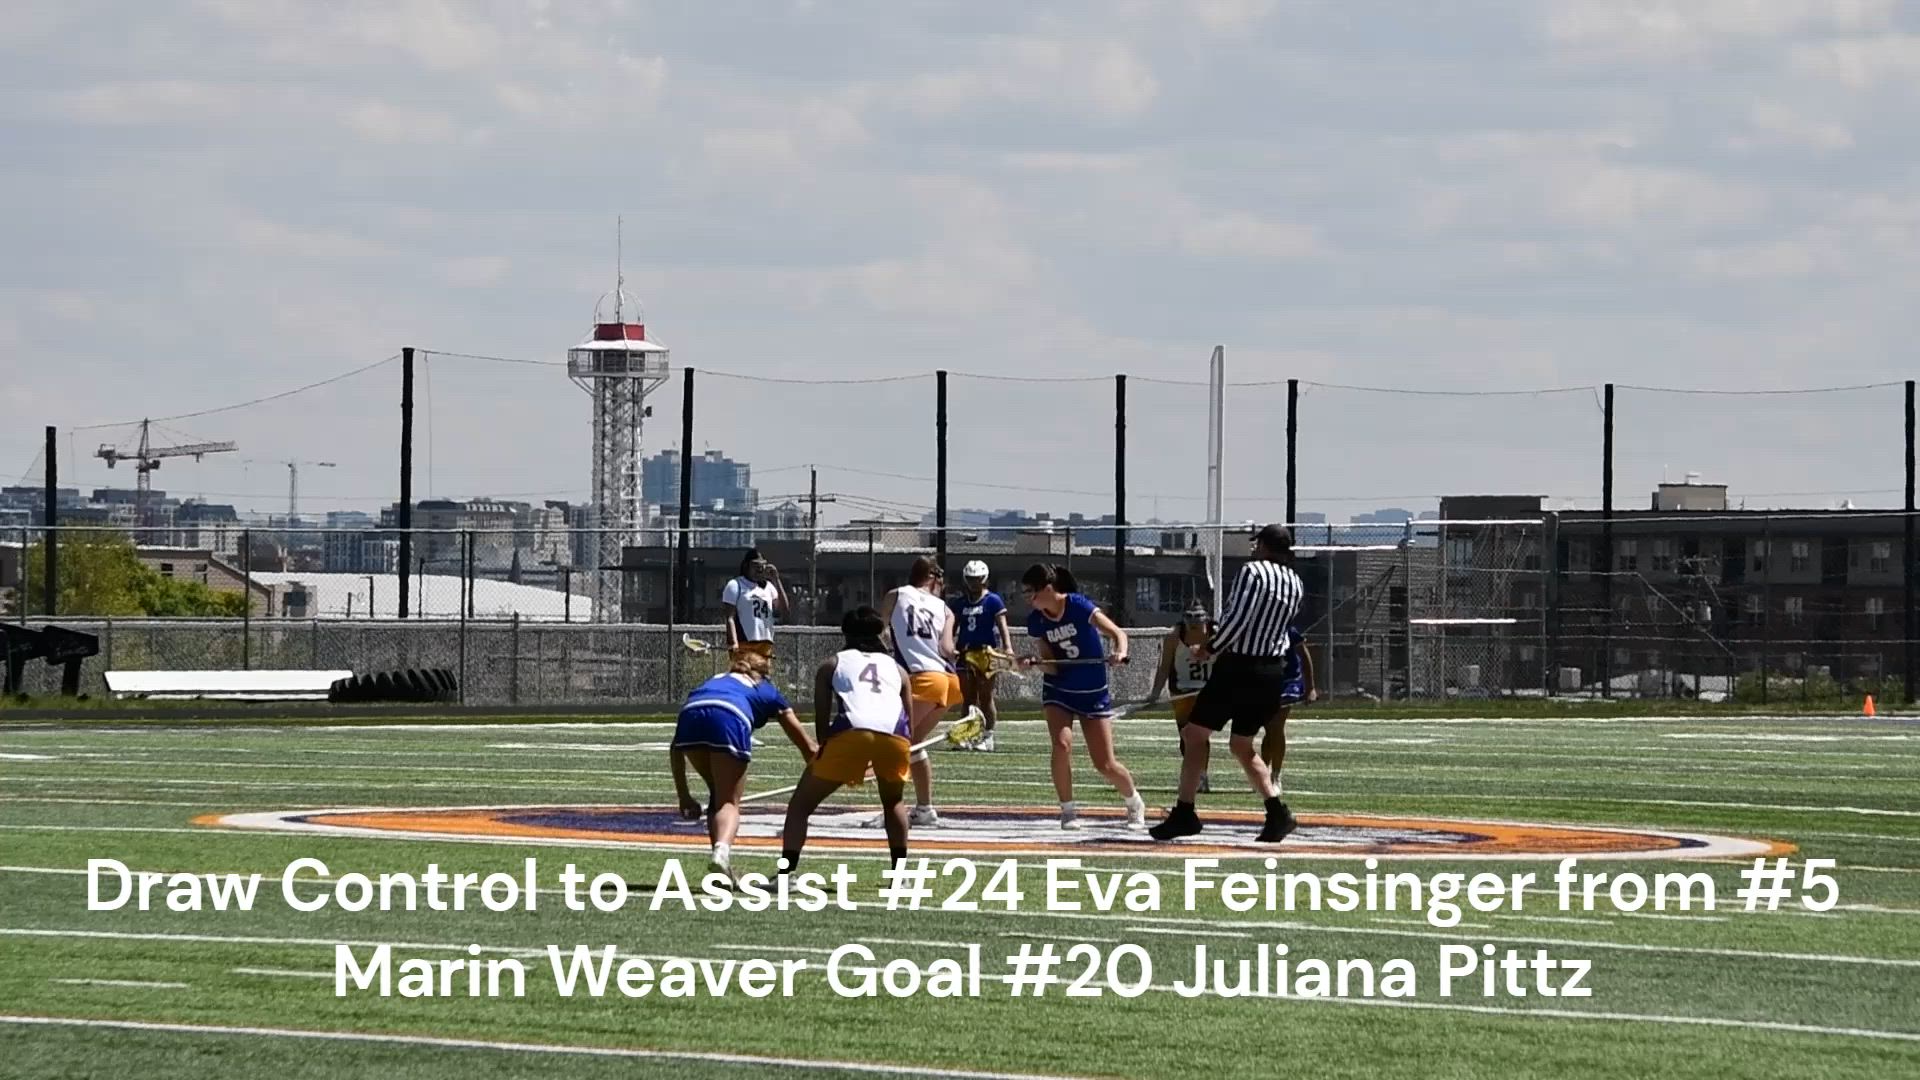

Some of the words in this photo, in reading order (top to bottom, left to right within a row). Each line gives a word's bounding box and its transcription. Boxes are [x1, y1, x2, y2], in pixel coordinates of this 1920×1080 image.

[752, 599, 769, 619] 24
[1046, 622, 1078, 643] RAMS
[1059, 640, 1080, 659] 5
[858, 662, 882, 694] 4
